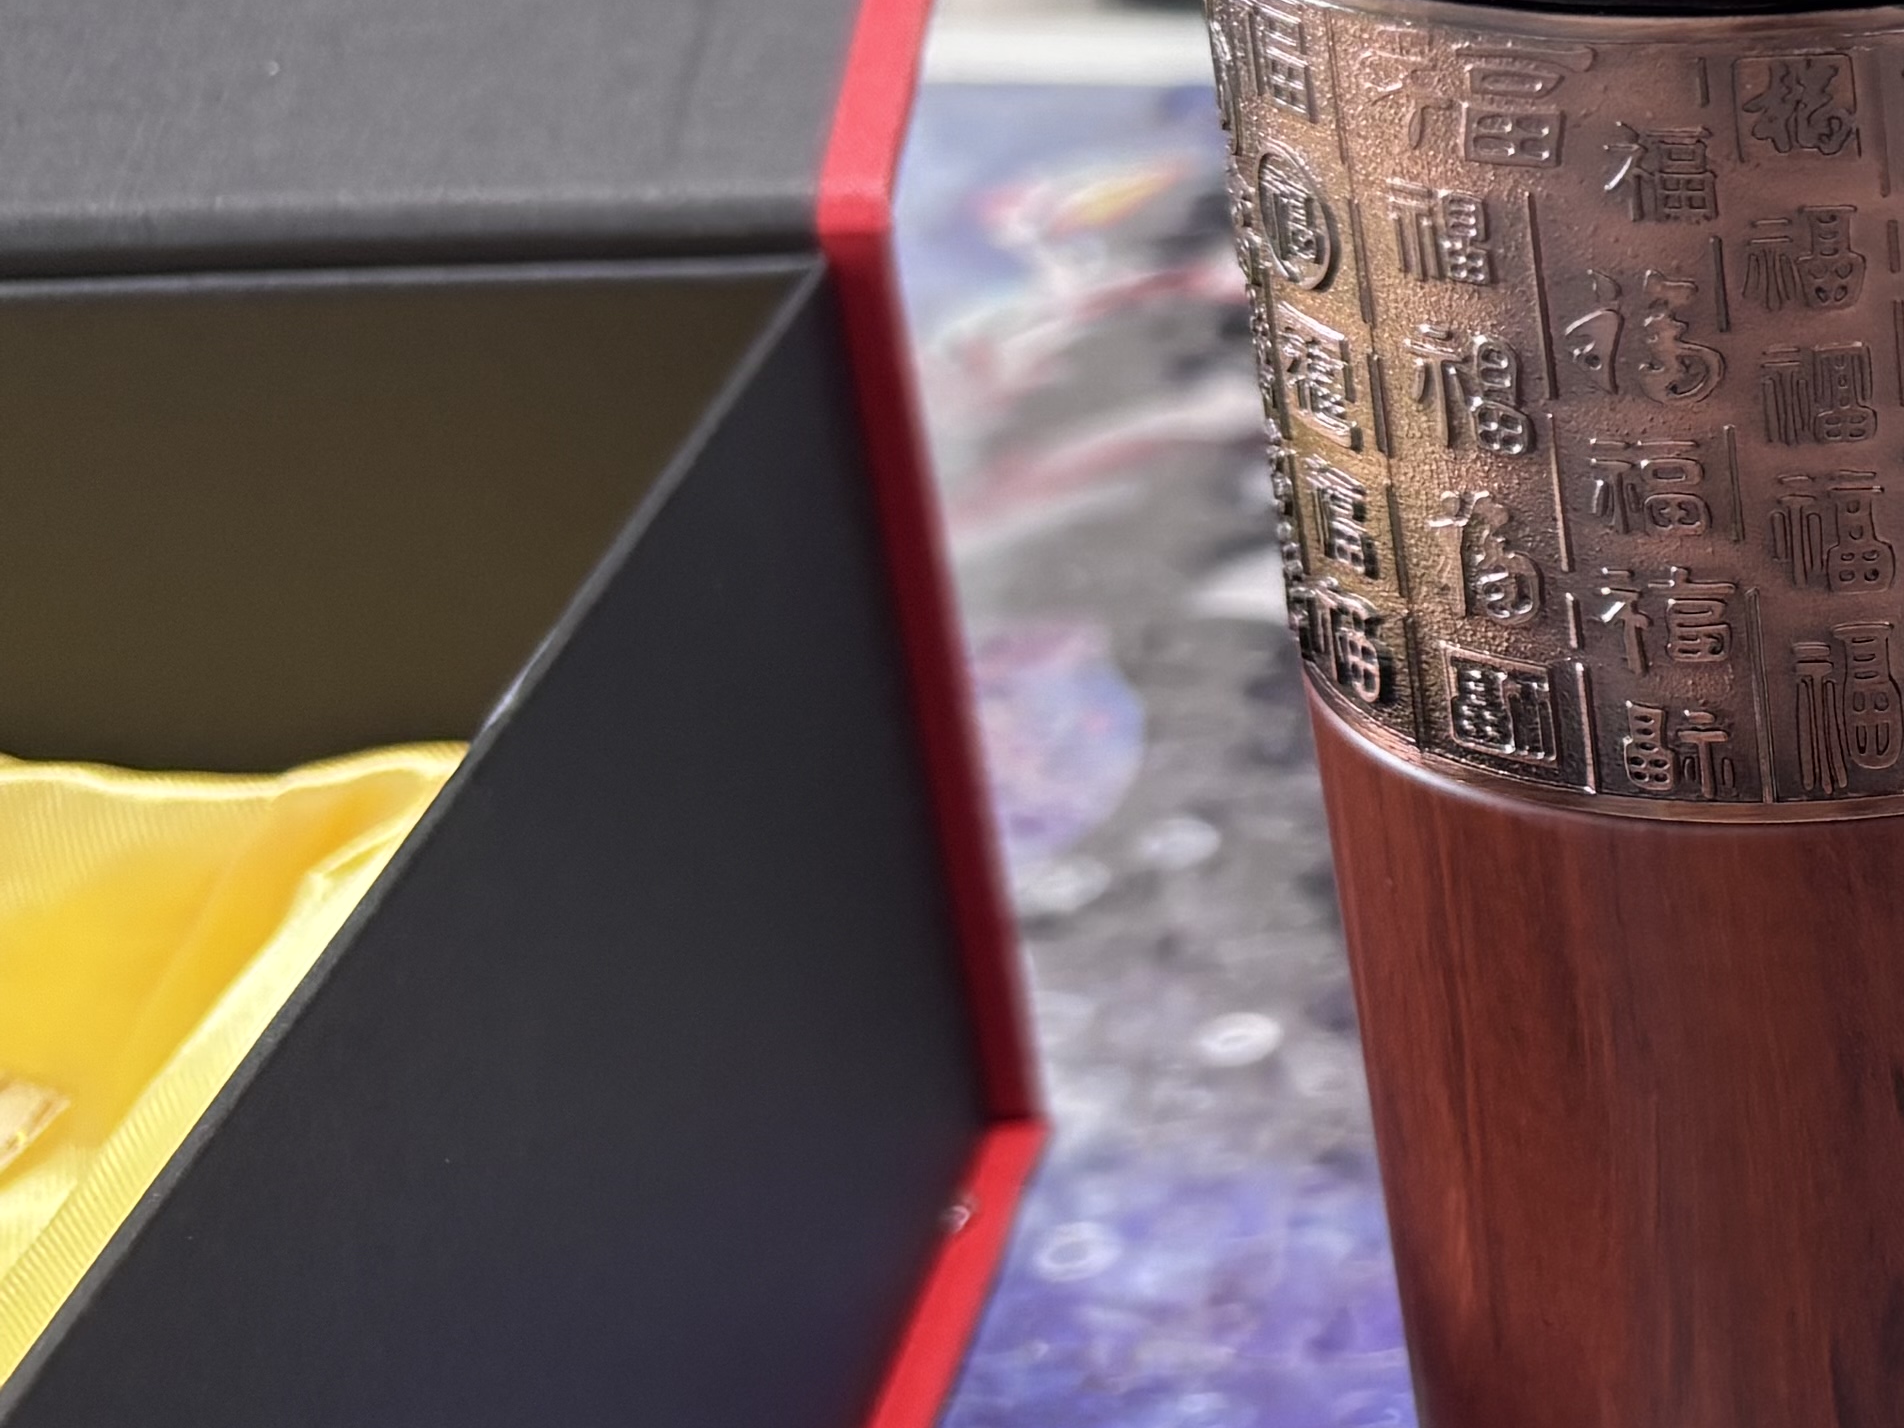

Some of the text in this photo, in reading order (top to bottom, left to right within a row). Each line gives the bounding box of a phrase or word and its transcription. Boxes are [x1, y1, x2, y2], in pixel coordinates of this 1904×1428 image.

[1743, 204, 1867, 312] 福
[1760, 341, 1878, 446] 福
[1770, 470, 1896, 593] 福
[1795, 621, 1904, 794] 福
